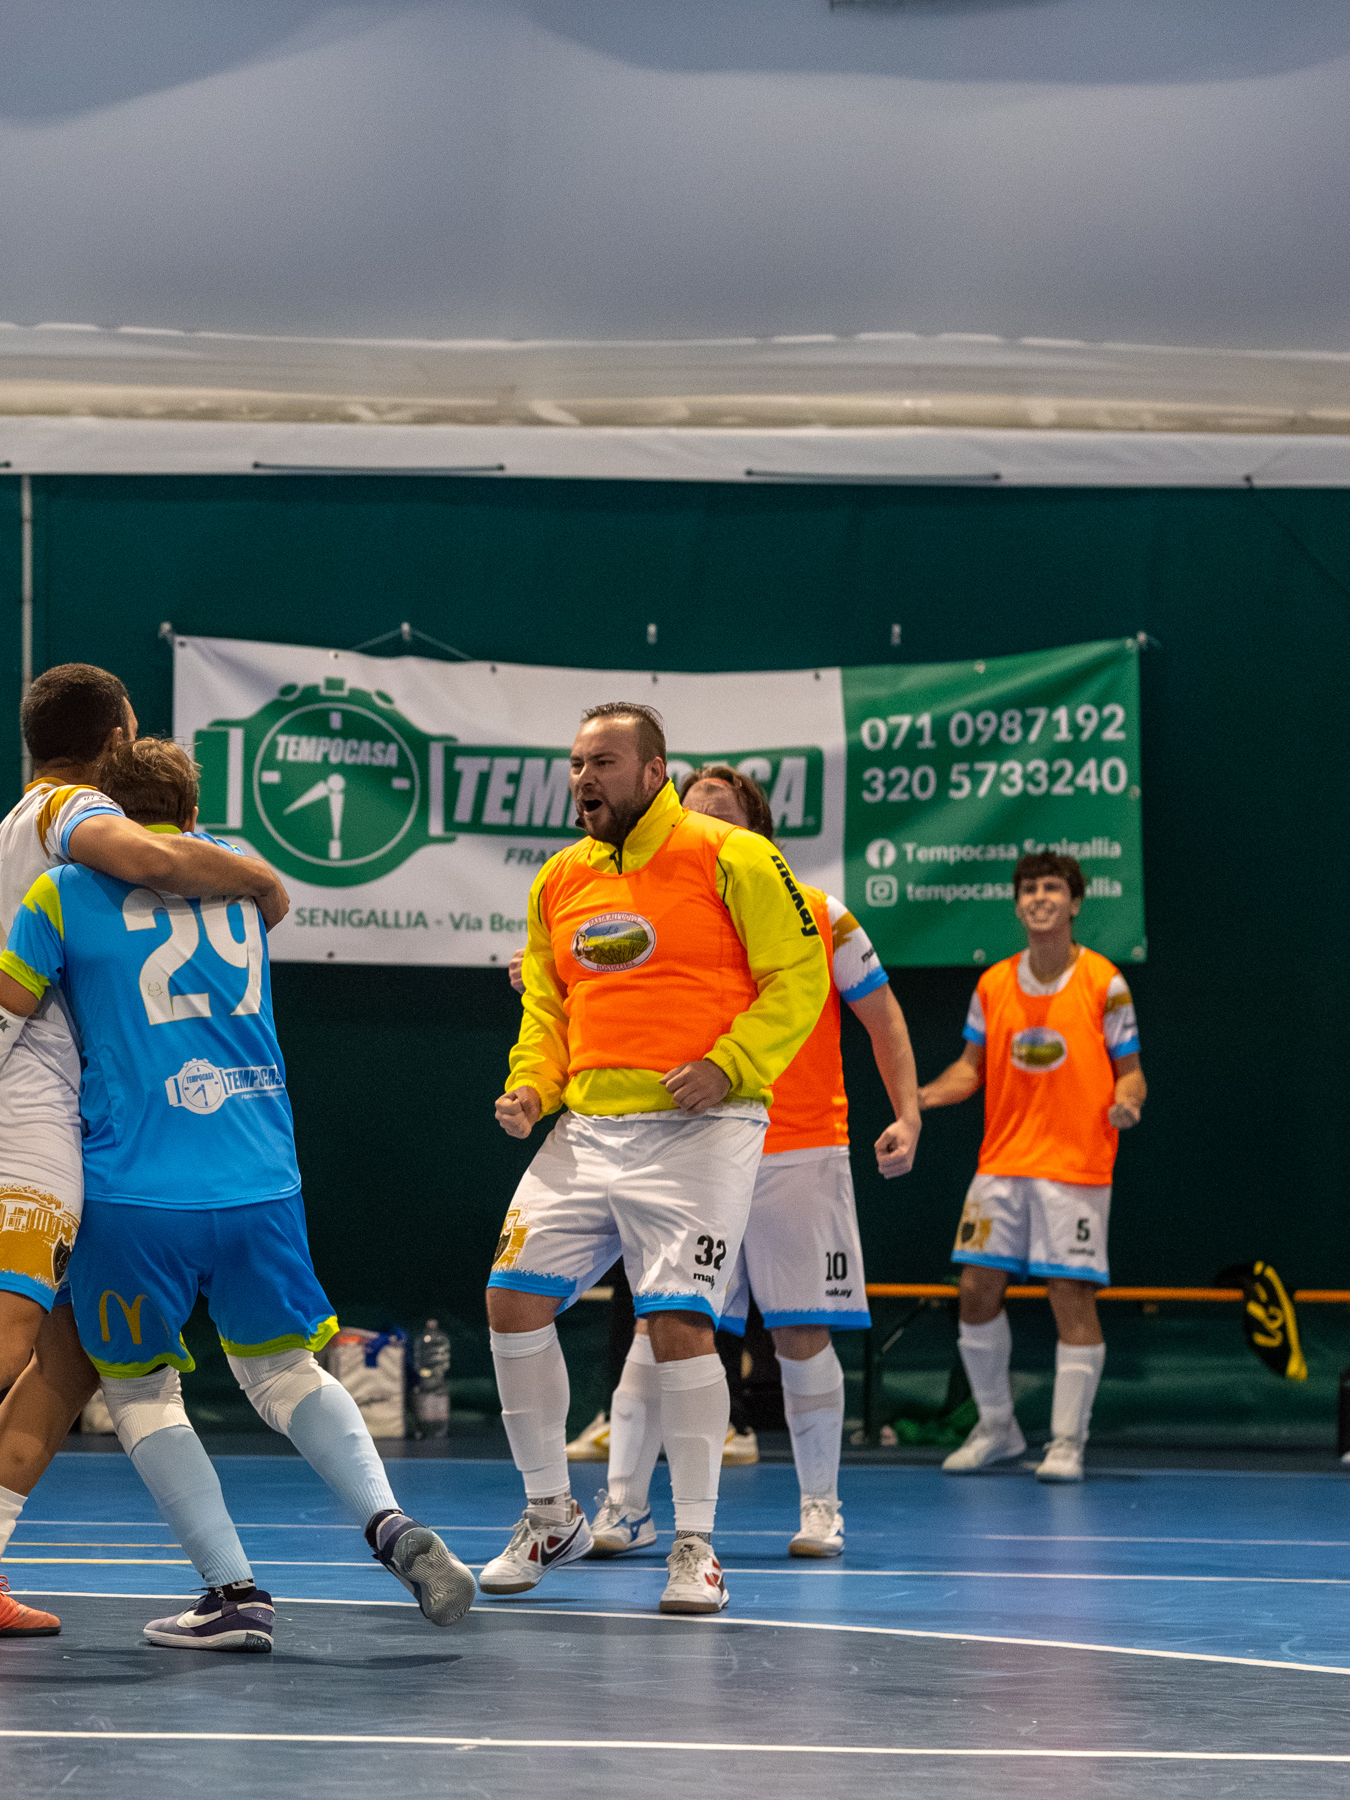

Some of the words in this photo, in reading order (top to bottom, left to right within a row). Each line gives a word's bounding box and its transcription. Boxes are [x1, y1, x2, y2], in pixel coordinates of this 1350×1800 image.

[861, 711, 938, 751] 071
[950, 703, 1127, 748] 0987192
[275, 733, 398, 767] TEMPOCASA
[862, 764, 938, 803] 320
[949, 756, 1129, 800] 5733240
[903, 841, 1019, 866] Tempocasa
[295, 906, 429, 930] SENIGALLIA
[450, 911, 484, 931] Via
[122, 888, 264, 1026] 29
[1076, 1217, 1090, 1242] 5
[694, 1234, 727, 1271] 32
[825, 1250, 848, 1282] 10
